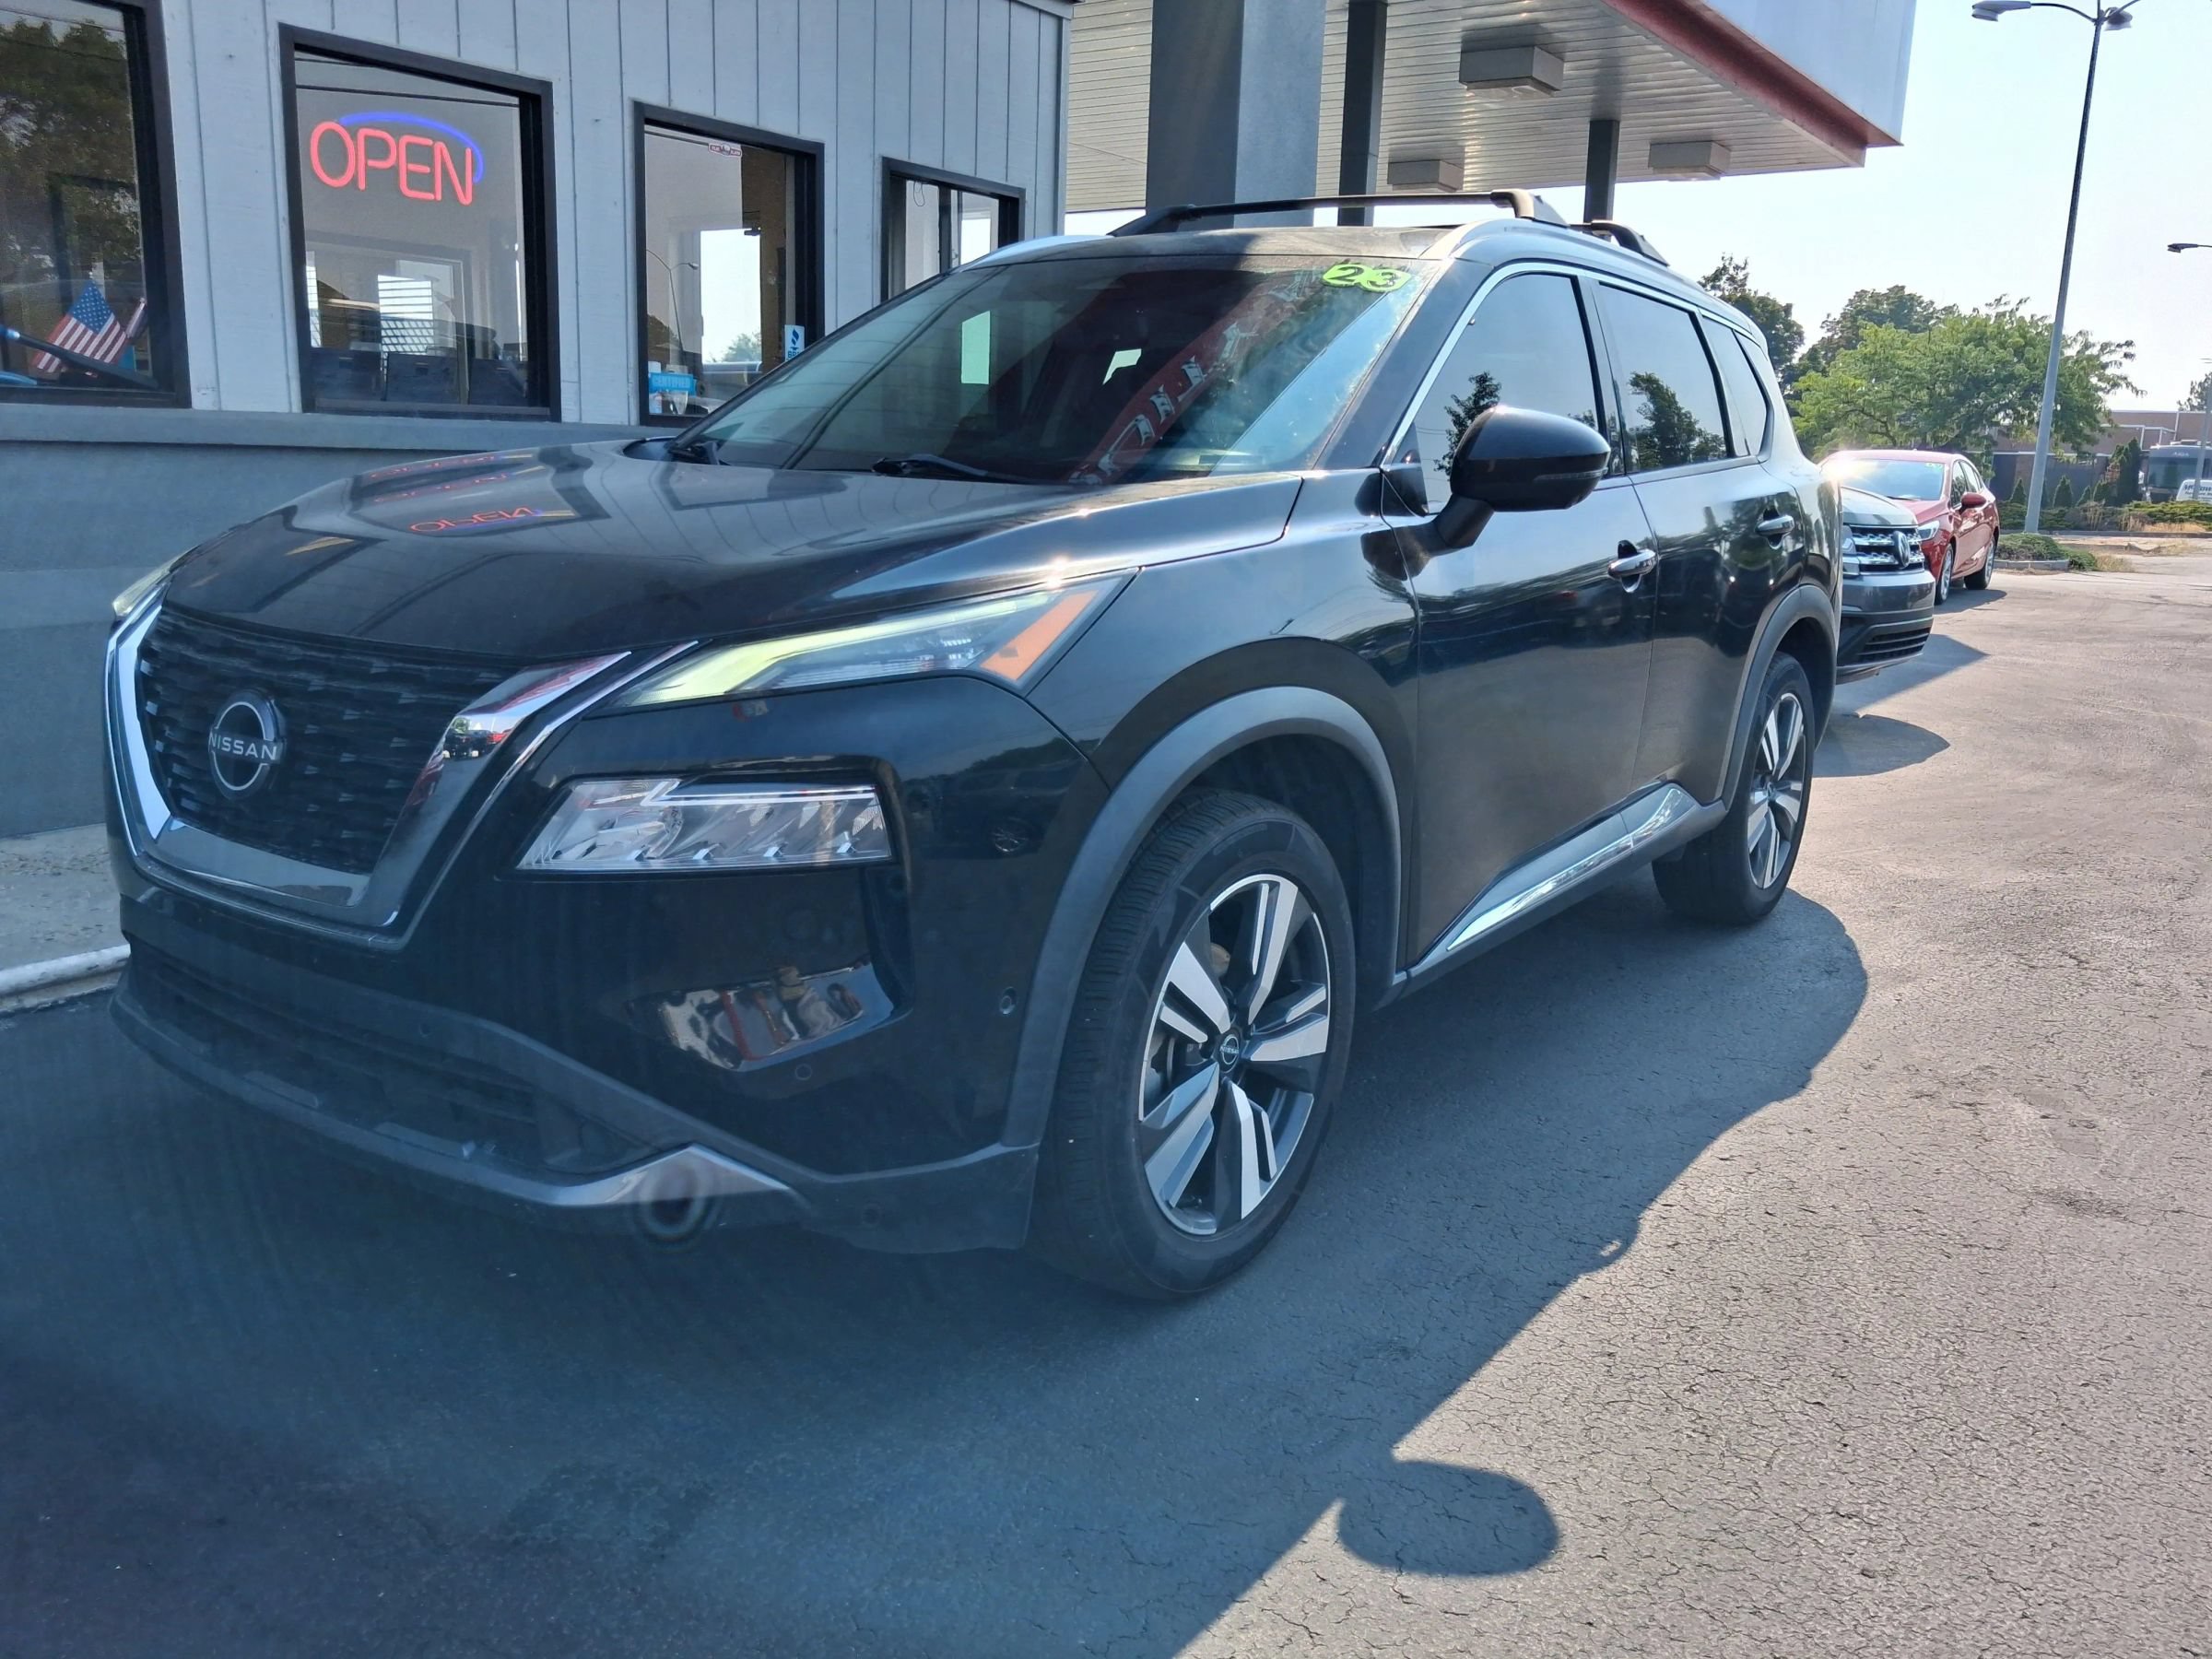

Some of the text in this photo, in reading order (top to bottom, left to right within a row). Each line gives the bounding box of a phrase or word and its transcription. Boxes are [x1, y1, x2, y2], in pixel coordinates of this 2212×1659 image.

[310, 121, 473, 206] OPEN
[1324, 265, 1401, 290] 23
[788, 350, 799, 359] BB
[208, 731, 277, 760] NISSAN
